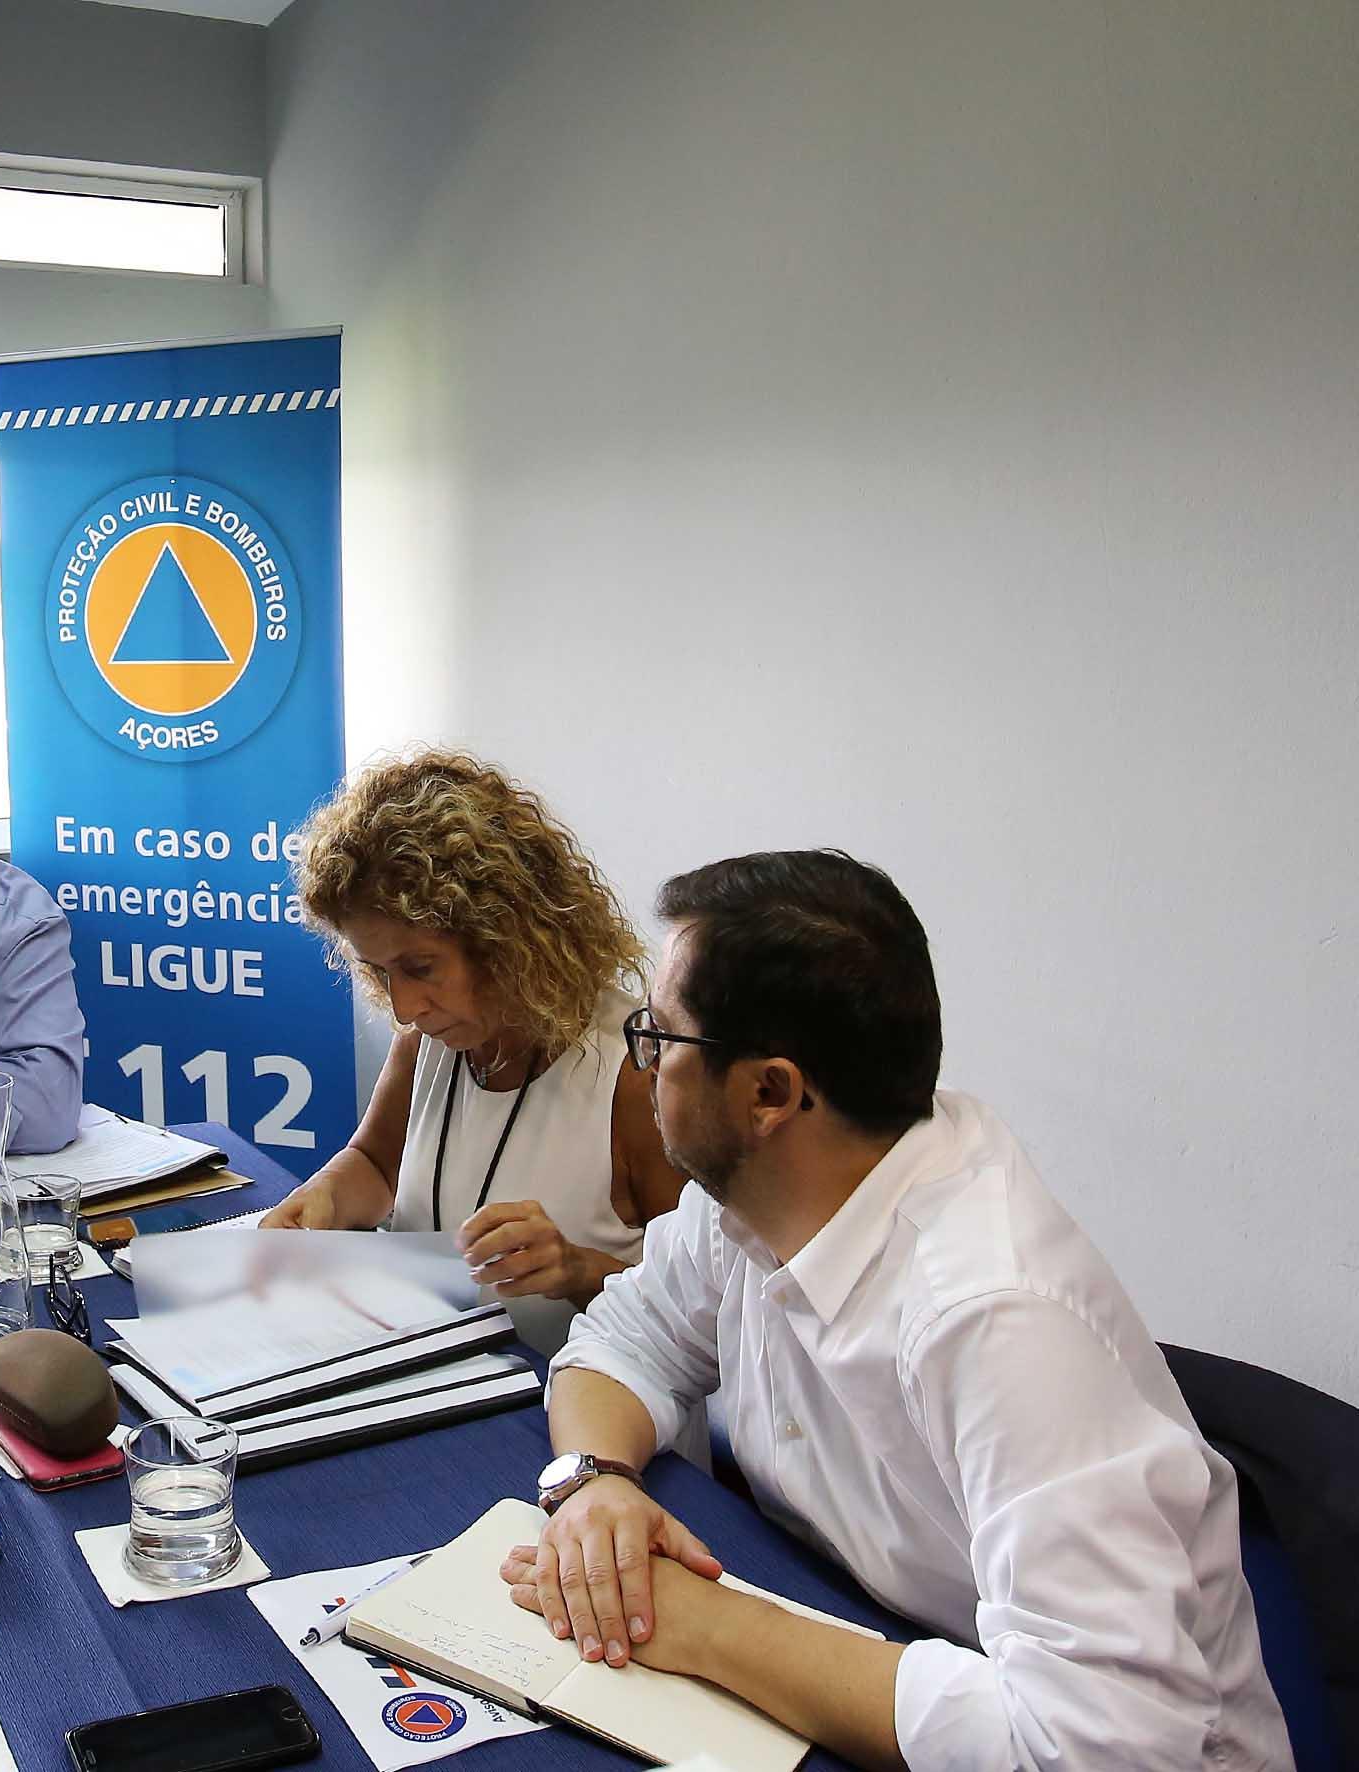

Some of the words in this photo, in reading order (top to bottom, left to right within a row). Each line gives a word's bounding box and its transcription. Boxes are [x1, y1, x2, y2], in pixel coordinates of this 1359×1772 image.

[58, 515, 119, 643] PROTEÇÃO
[120, 492, 179, 522] CIVIL
[185, 494, 201, 515] E
[203, 504, 287, 641] BOMBEIROS
[118, 719, 219, 750] AÇORES
[55, 816, 115, 855] Em
[134, 826, 231, 860] caso
[251, 821, 304, 863] de
[57, 880, 304, 927] emergência
[100, 941, 265, 997] LIGUE
[117, 1044, 316, 1149] 112
[480, 1699, 506, 1722] Aviso
